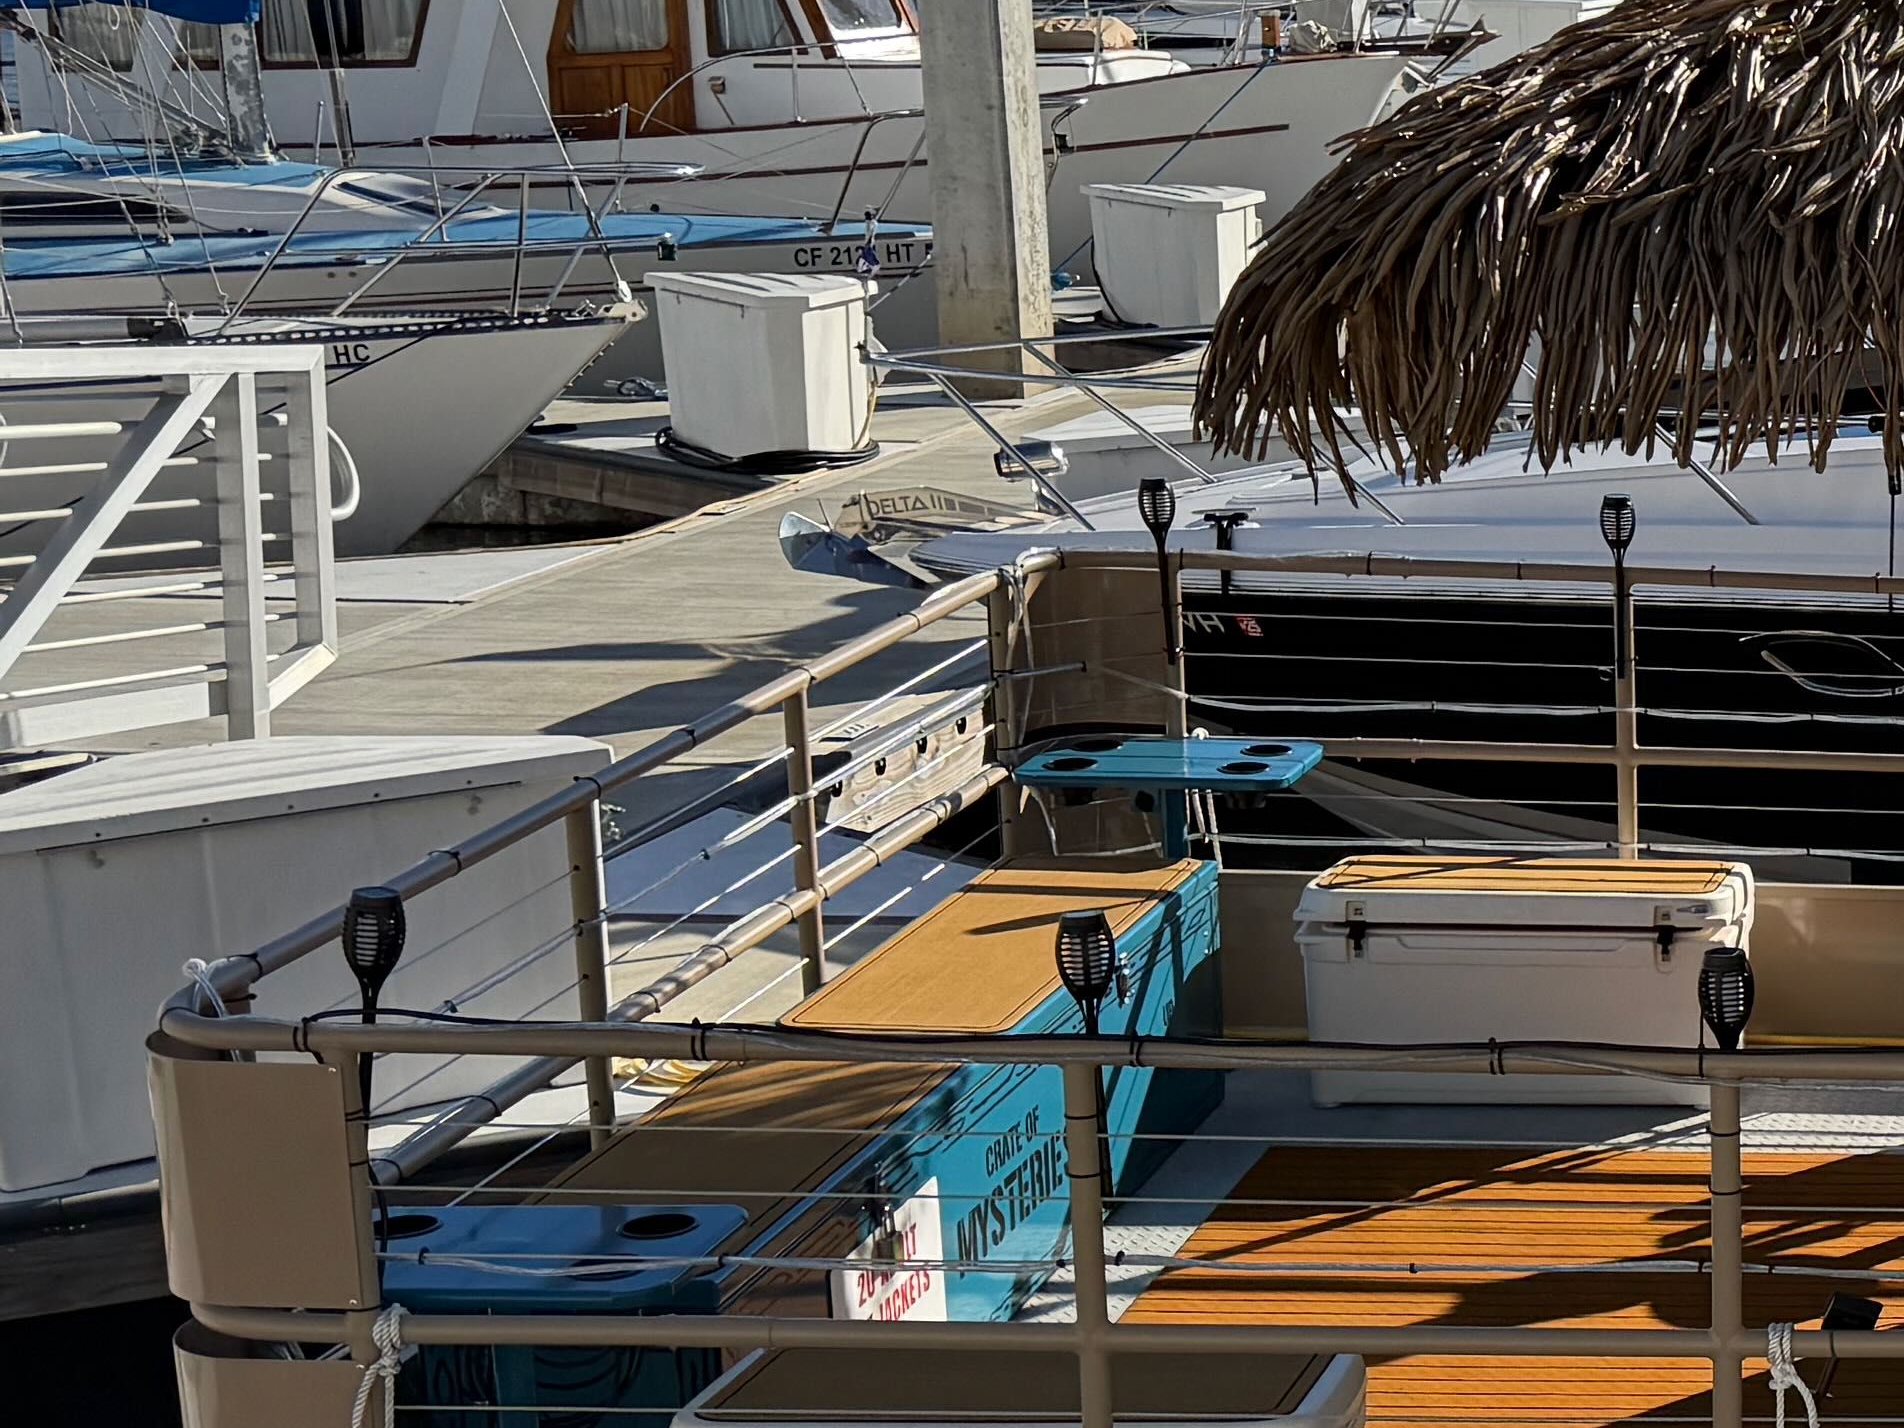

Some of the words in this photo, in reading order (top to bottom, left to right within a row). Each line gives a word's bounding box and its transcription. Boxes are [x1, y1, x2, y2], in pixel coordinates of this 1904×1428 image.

[794, 247, 822, 268] CF
[886, 243, 914, 263] HT
[333, 343, 370, 364] HC
[986, 1121, 1023, 1179] CRATE
[1025, 1104, 1040, 1143] OF
[956, 1126, 1070, 1280] MYSTERIE
